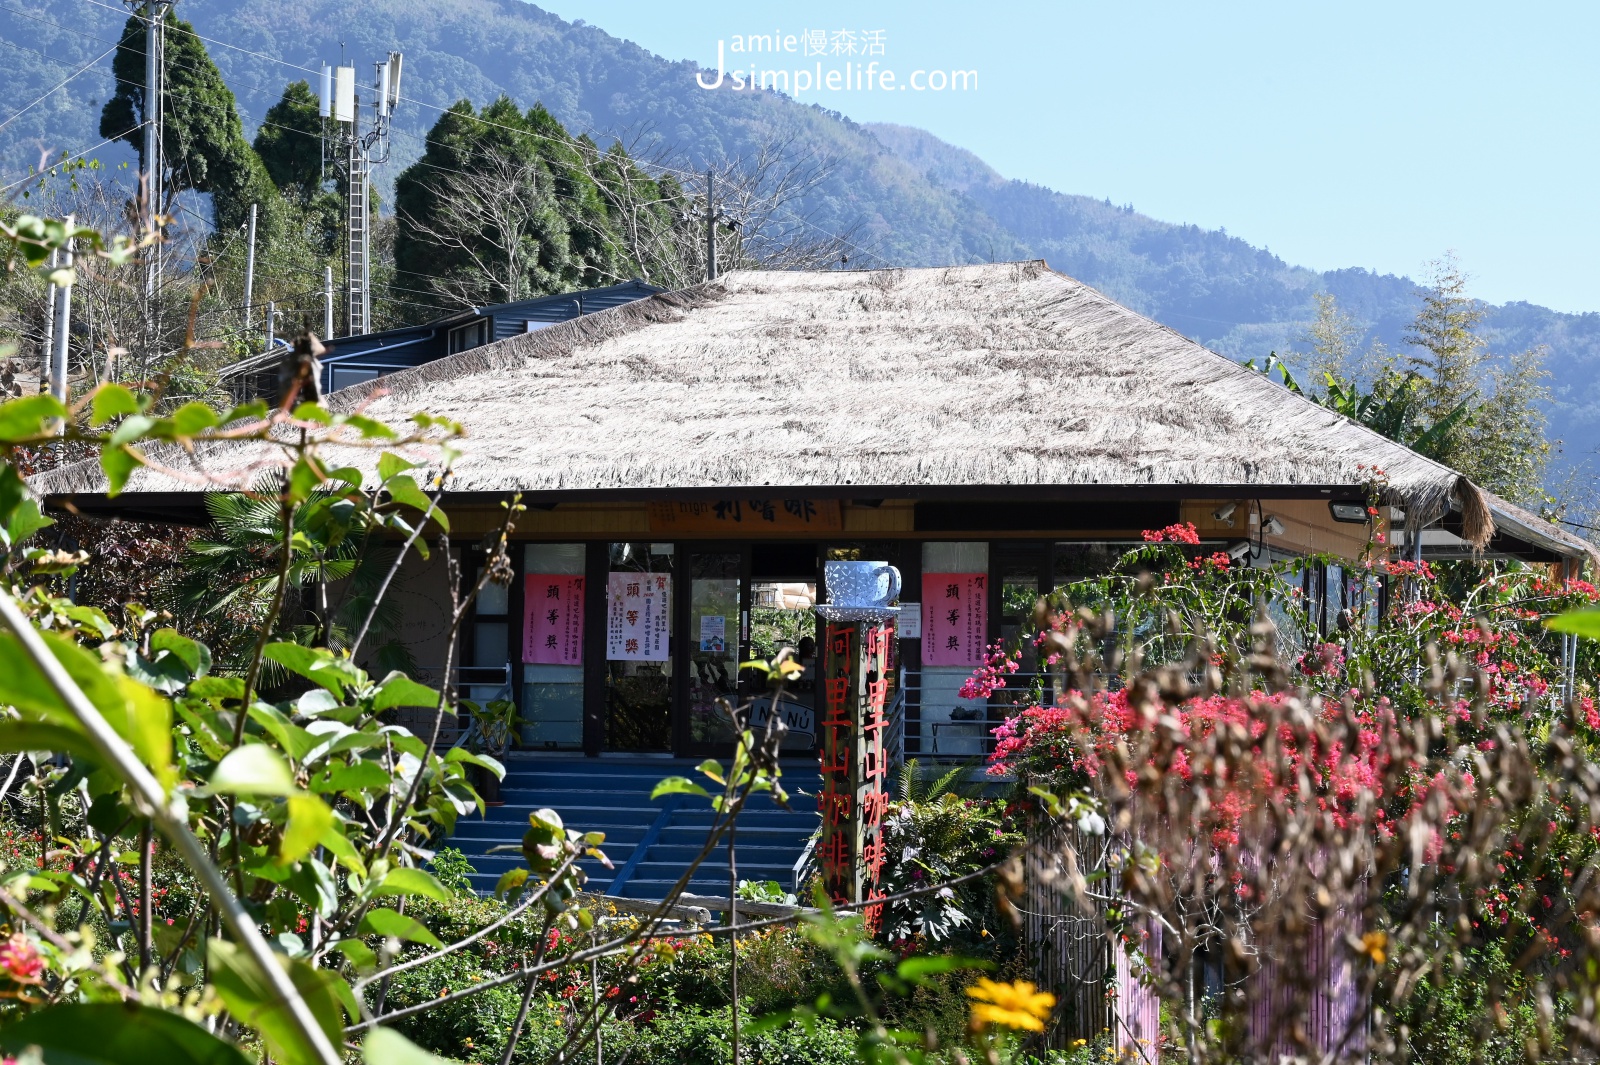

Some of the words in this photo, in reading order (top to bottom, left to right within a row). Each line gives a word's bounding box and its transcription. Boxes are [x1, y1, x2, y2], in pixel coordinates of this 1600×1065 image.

[575, 579, 583, 591] 賀
[656, 576, 667, 590] 賀
[975, 577, 985, 590] 賀
[546, 585, 560, 650] 頭等獎
[626, 583, 640, 655] 頭等獎
[946, 584, 960, 652] 頭等獎
